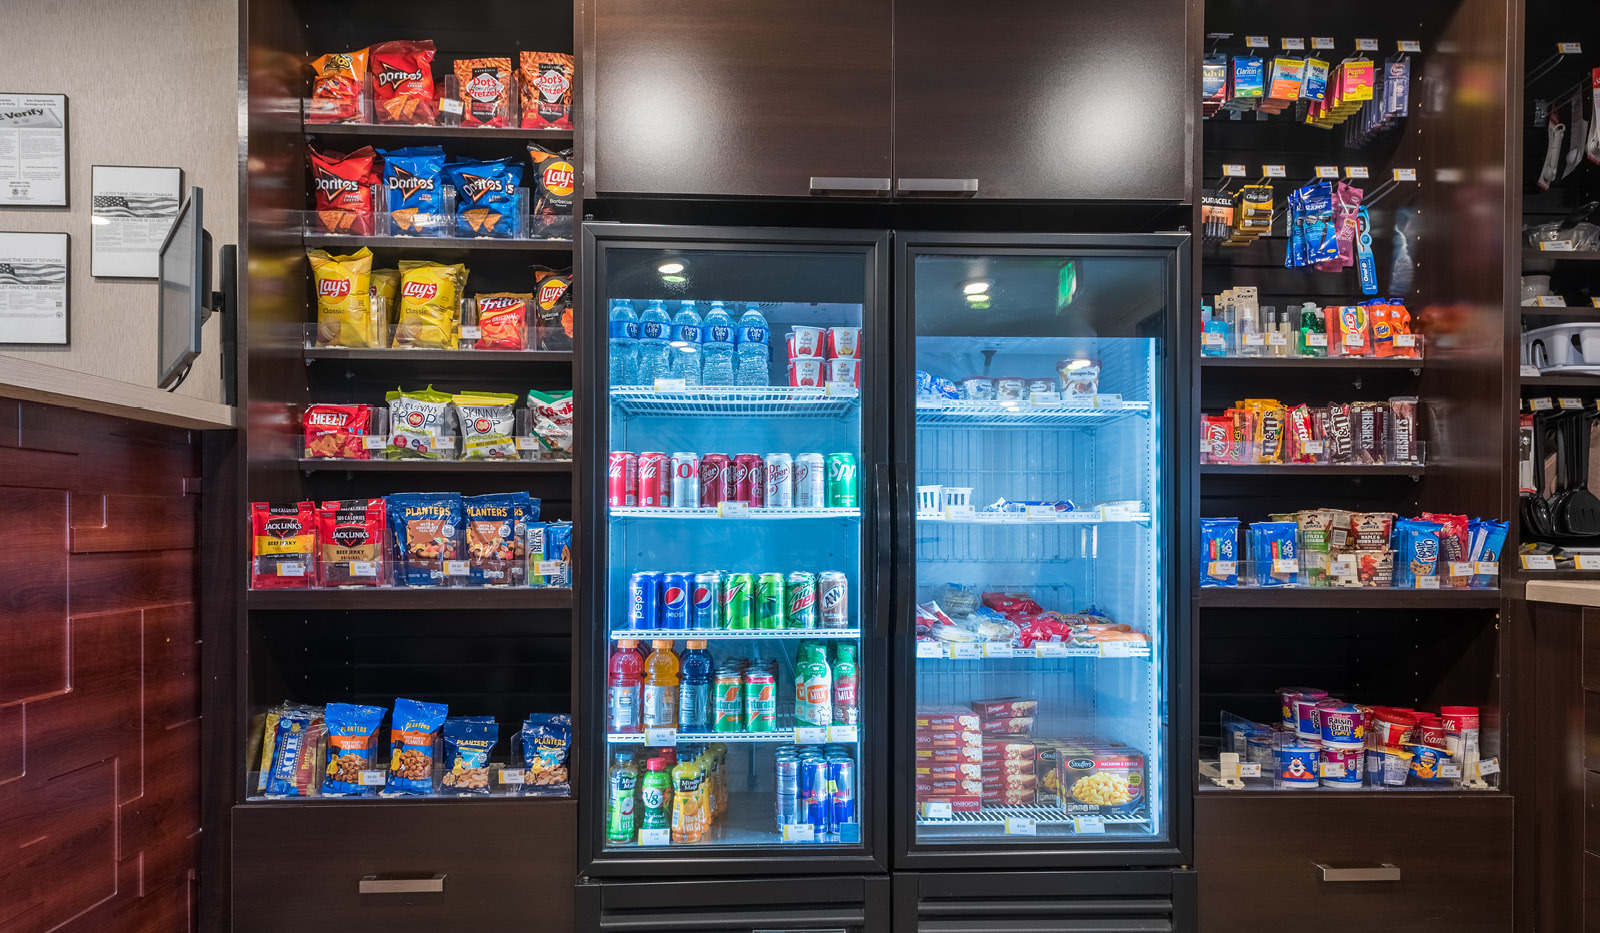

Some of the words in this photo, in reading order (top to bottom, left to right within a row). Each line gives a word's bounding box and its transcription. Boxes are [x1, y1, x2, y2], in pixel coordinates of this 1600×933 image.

[1236, 67, 1257, 75] Claritin
[379, 69, 422, 87] Doritos
[473, 76, 497, 87] Dot's
[540, 74, 563, 85] Dot's
[469, 88, 501, 98] Pretzels
[315, 177, 359, 191] Doritos
[389, 176, 434, 190] Doritos
[463, 179, 502, 196] Doritos
[1202, 197, 1232, 206] DURACELL
[1305, 201, 1328, 211] Razor
[320, 278, 349, 297] Lay's
[403, 282, 436, 299] Lay's
[541, 284, 568, 303] Lay's
[1375, 325, 1389, 335] Tide
[463, 407, 500, 418] SKINNY
[1361, 410, 1374, 449] HERSHEY'S
[1396, 419, 1409, 459] HERSHEY'S
[405, 506, 450, 517] PLANTERS
[467, 507, 508, 517] PLANTERS
[265, 523, 281, 531] JACK
[281, 522, 302, 530] LINK'S
[635, 586, 644, 619] pepsi
[666, 611, 684, 619] pepsi
[811, 691, 825, 701] MILK
[837, 690, 855, 701] MILK
[405, 722, 430, 731] PLANTERS
[1328, 717, 1353, 726] Raisin
[340, 725, 367, 733] PLANTERS
[1331, 724, 1350, 732] Bran
[456, 739, 488, 748] PLANTERS
[534, 738, 566, 746] PLANTERS
[1070, 760, 1092, 768] Stouffer's
[644, 790, 659, 806] V8
